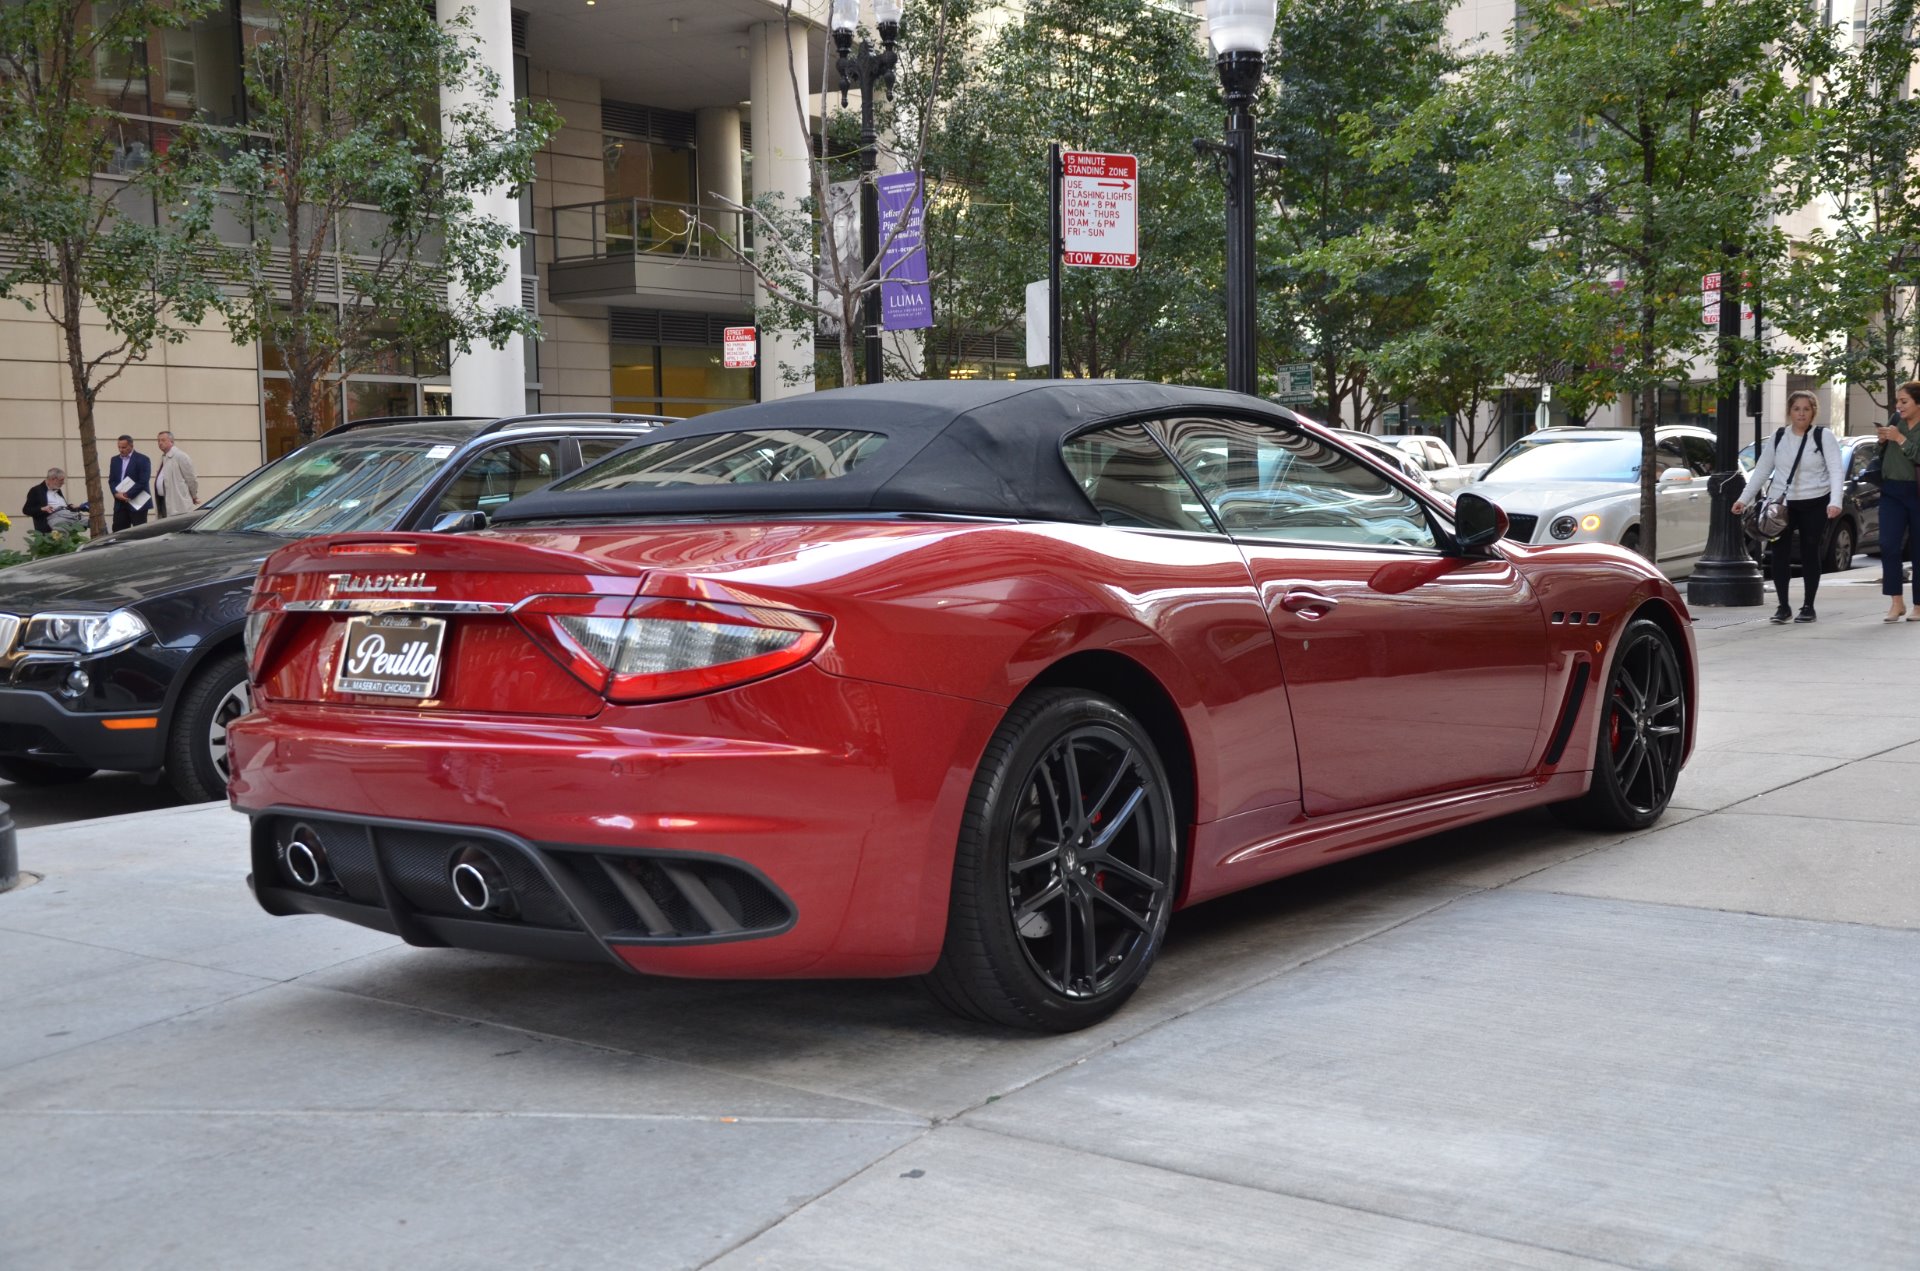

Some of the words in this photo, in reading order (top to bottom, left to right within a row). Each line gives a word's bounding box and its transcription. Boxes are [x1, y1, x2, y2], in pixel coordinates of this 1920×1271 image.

[1067, 155, 1076, 164] 15
[1077, 156, 1106, 166] MINUTE
[1067, 165, 1105, 176] STANDING
[1108, 167, 1129, 177] ZONE
[1067, 180, 1083, 189] USE
[1067, 190, 1105, 200] FLASHING
[1106, 192, 1133, 201] LIGHTS
[1067, 199, 1076, 208] 10
[1077, 200, 1090, 208] AM
[1097, 201, 1103, 209] 8
[1105, 201, 1117, 209] PM
[1067, 209, 1085, 217] MON
[1094, 210, 1120, 219] THURS
[1067, 218, 1076, 227] 10
[1077, 218, 1089, 227] AM
[1097, 220, 1103, 228] 6
[1104, 220, 1116, 228] PM
[1067, 228, 1081, 236] FRI
[1088, 228, 1105, 237] SUN
[1069, 252, 1093, 264] TOW
[1100, 254, 1131, 265] ZONE
[890, 294, 923, 308] LUMA
[328, 572, 437, 592] Maserati
[380, 615, 412, 627] Perillo
[347, 633, 435, 678] Perillo
[352, 681, 382, 691] MASERATI
[383, 683, 411, 693] CHICAGO
